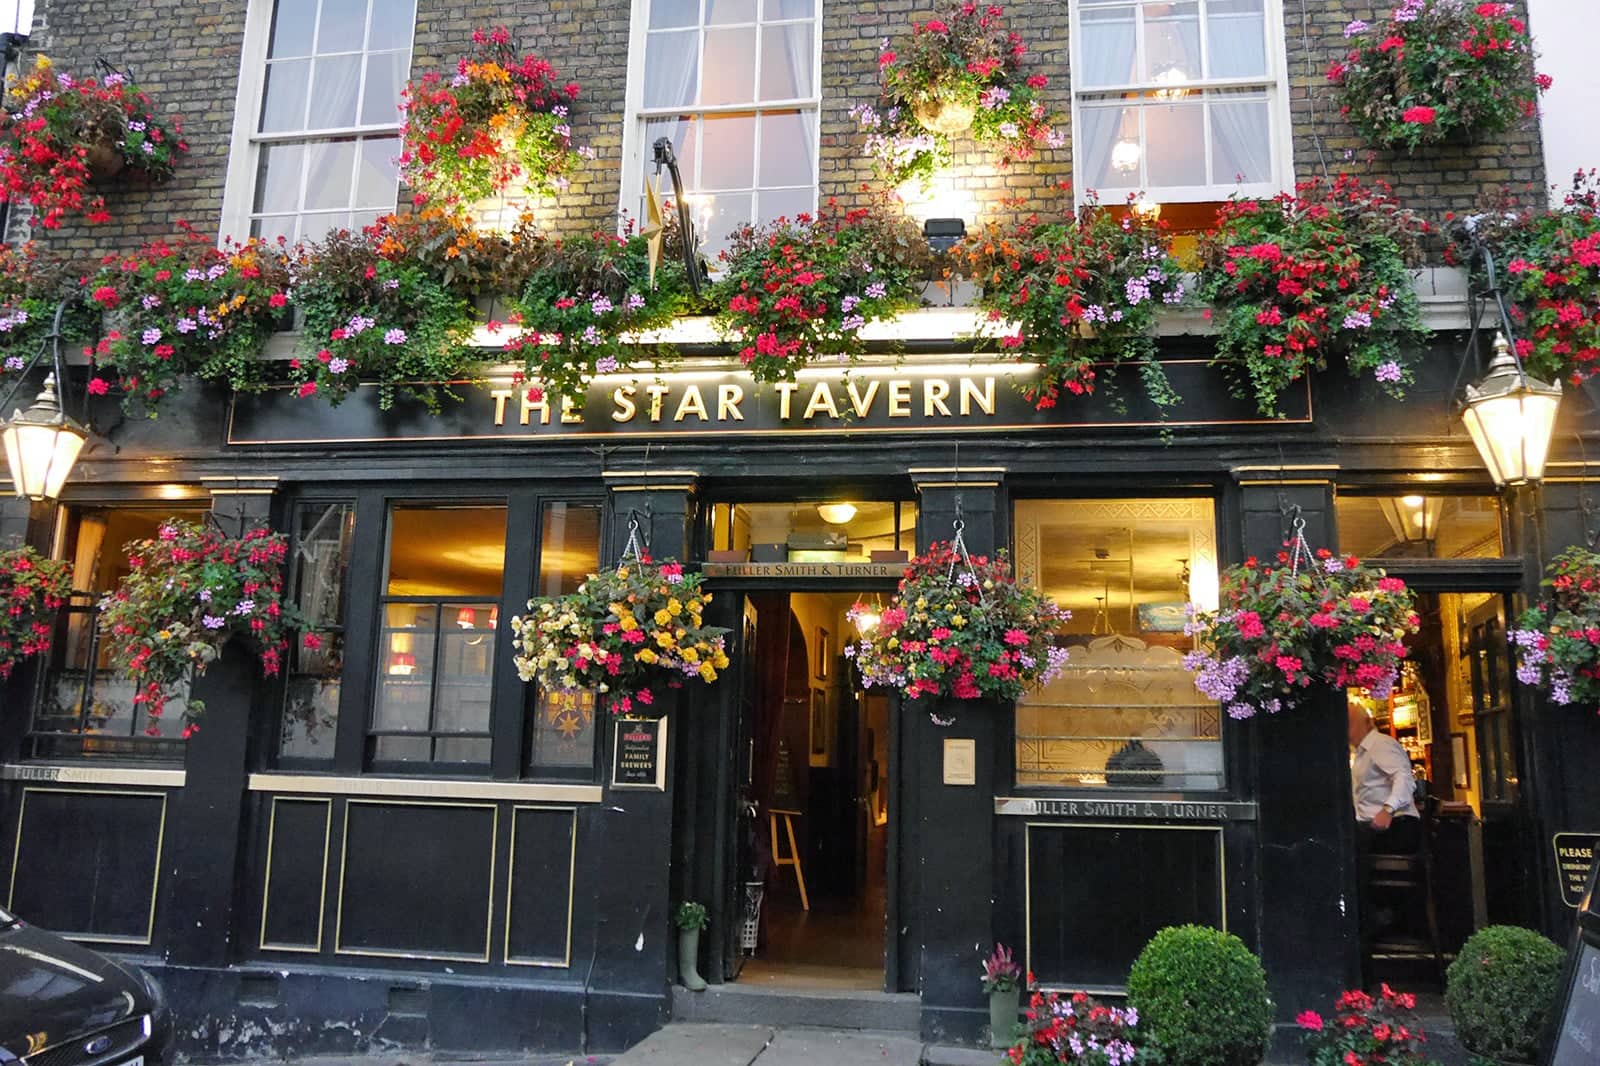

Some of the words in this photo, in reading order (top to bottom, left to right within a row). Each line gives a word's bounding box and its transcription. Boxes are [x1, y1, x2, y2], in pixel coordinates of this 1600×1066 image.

[612, 384, 744, 423] STAR
[775, 377, 996, 420] TAVERN
[774, 564, 817, 576] SMITH
[822, 565, 832, 576] &
[836, 565, 888, 576] TURNER
[1084, 801, 1138, 817] SMITH
[1143, 802, 1158, 817] &
[1164, 801, 1228, 819] TURNER
[1559, 847, 1593, 858] PLEASE
